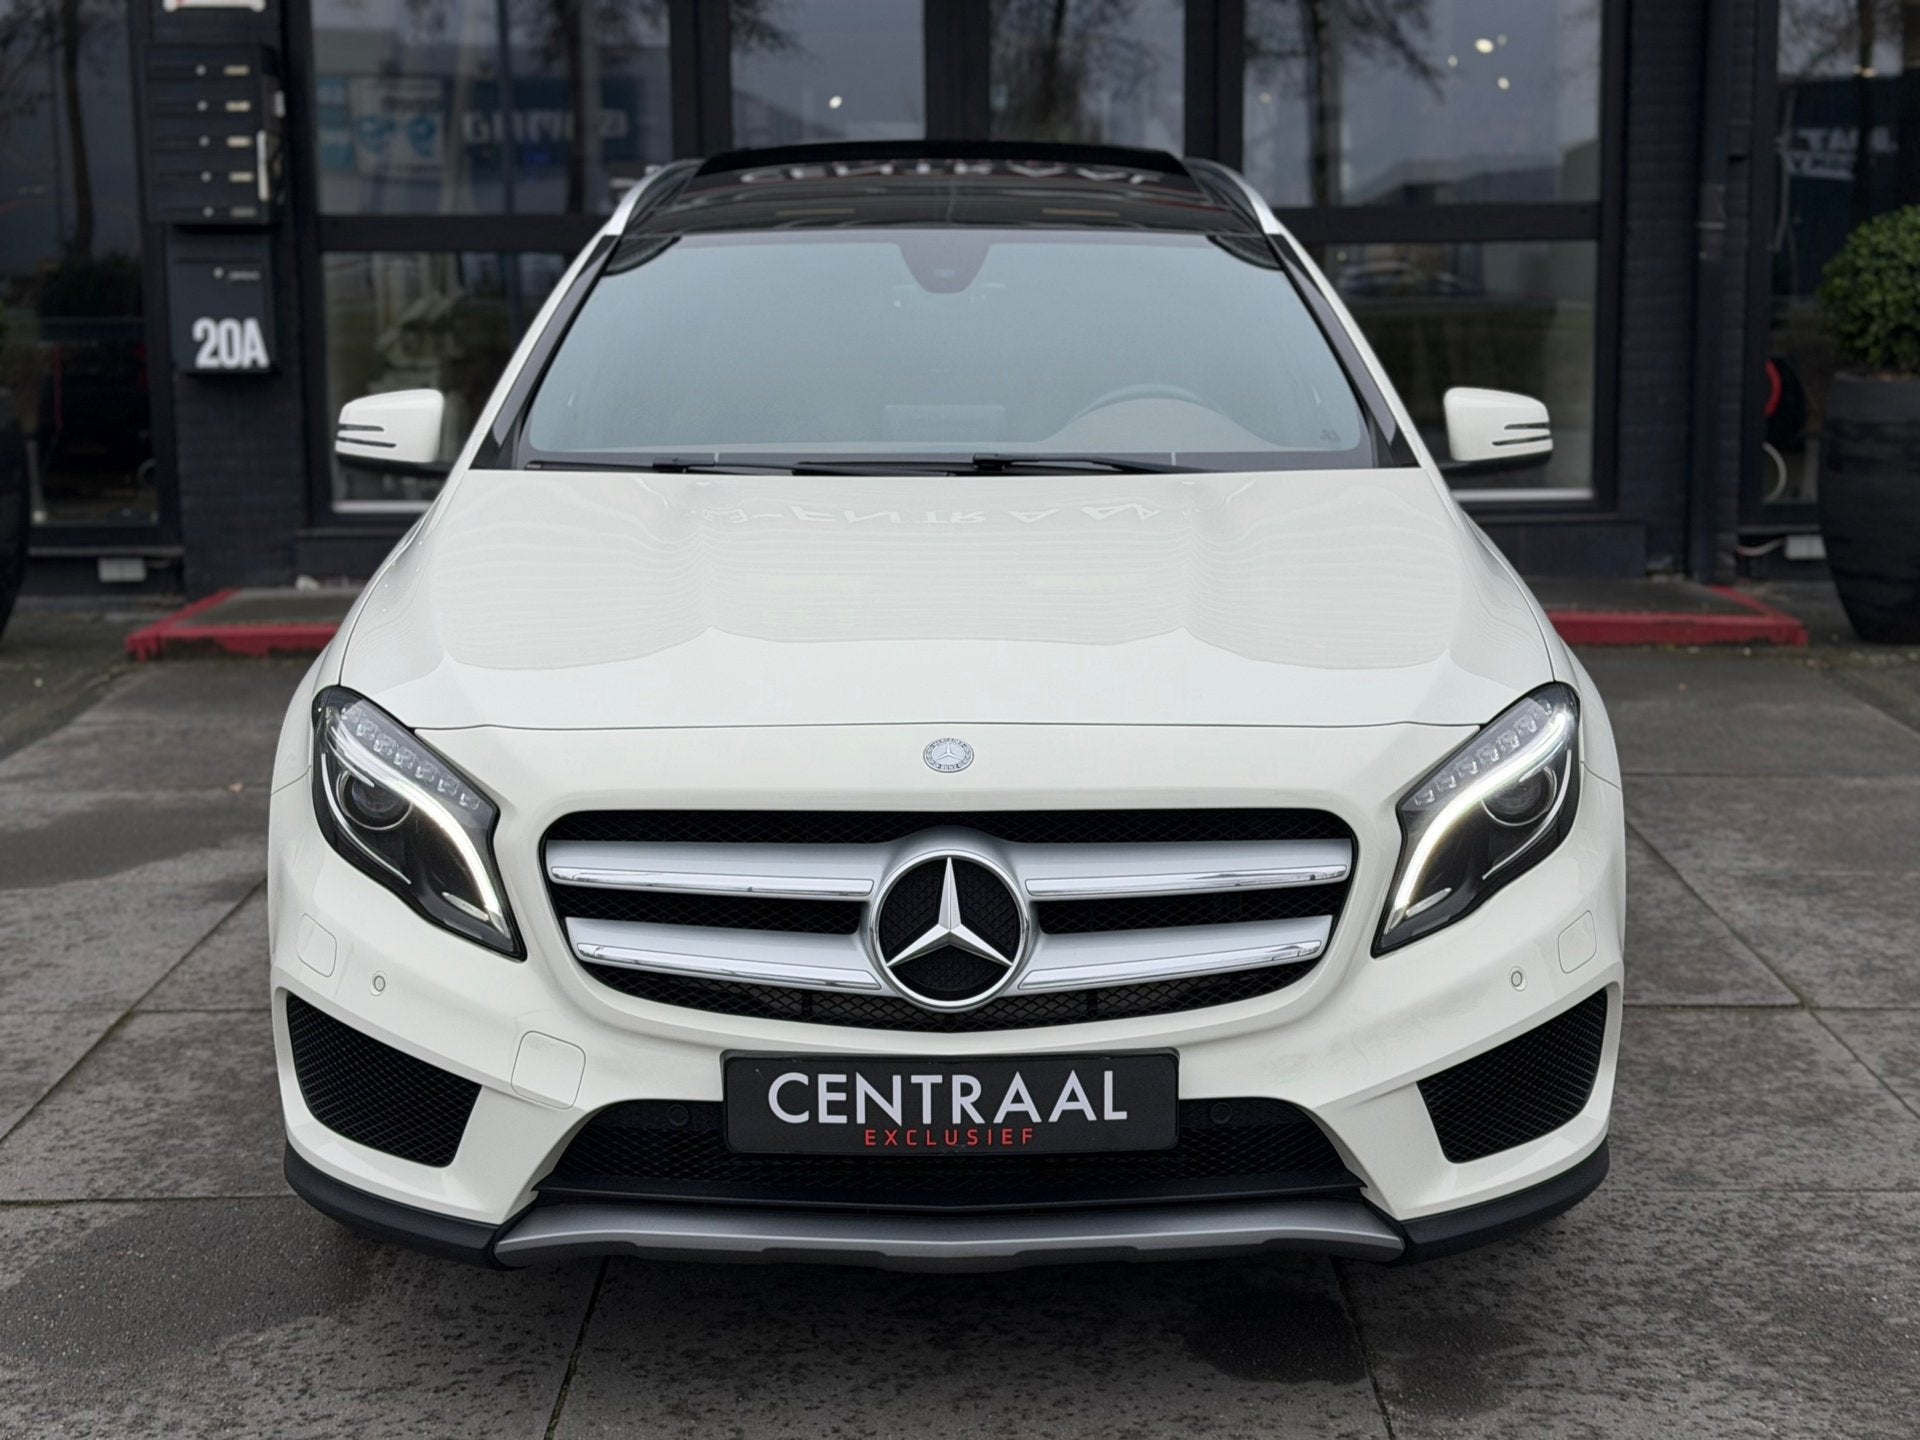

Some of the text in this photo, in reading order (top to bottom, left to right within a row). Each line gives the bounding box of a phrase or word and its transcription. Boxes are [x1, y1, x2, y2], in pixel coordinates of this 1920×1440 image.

[193, 317, 270, 369] 20A
[768, 1069, 1128, 1126] CENTRAAL
[864, 1127, 1035, 1147] EXCLUSIEF
